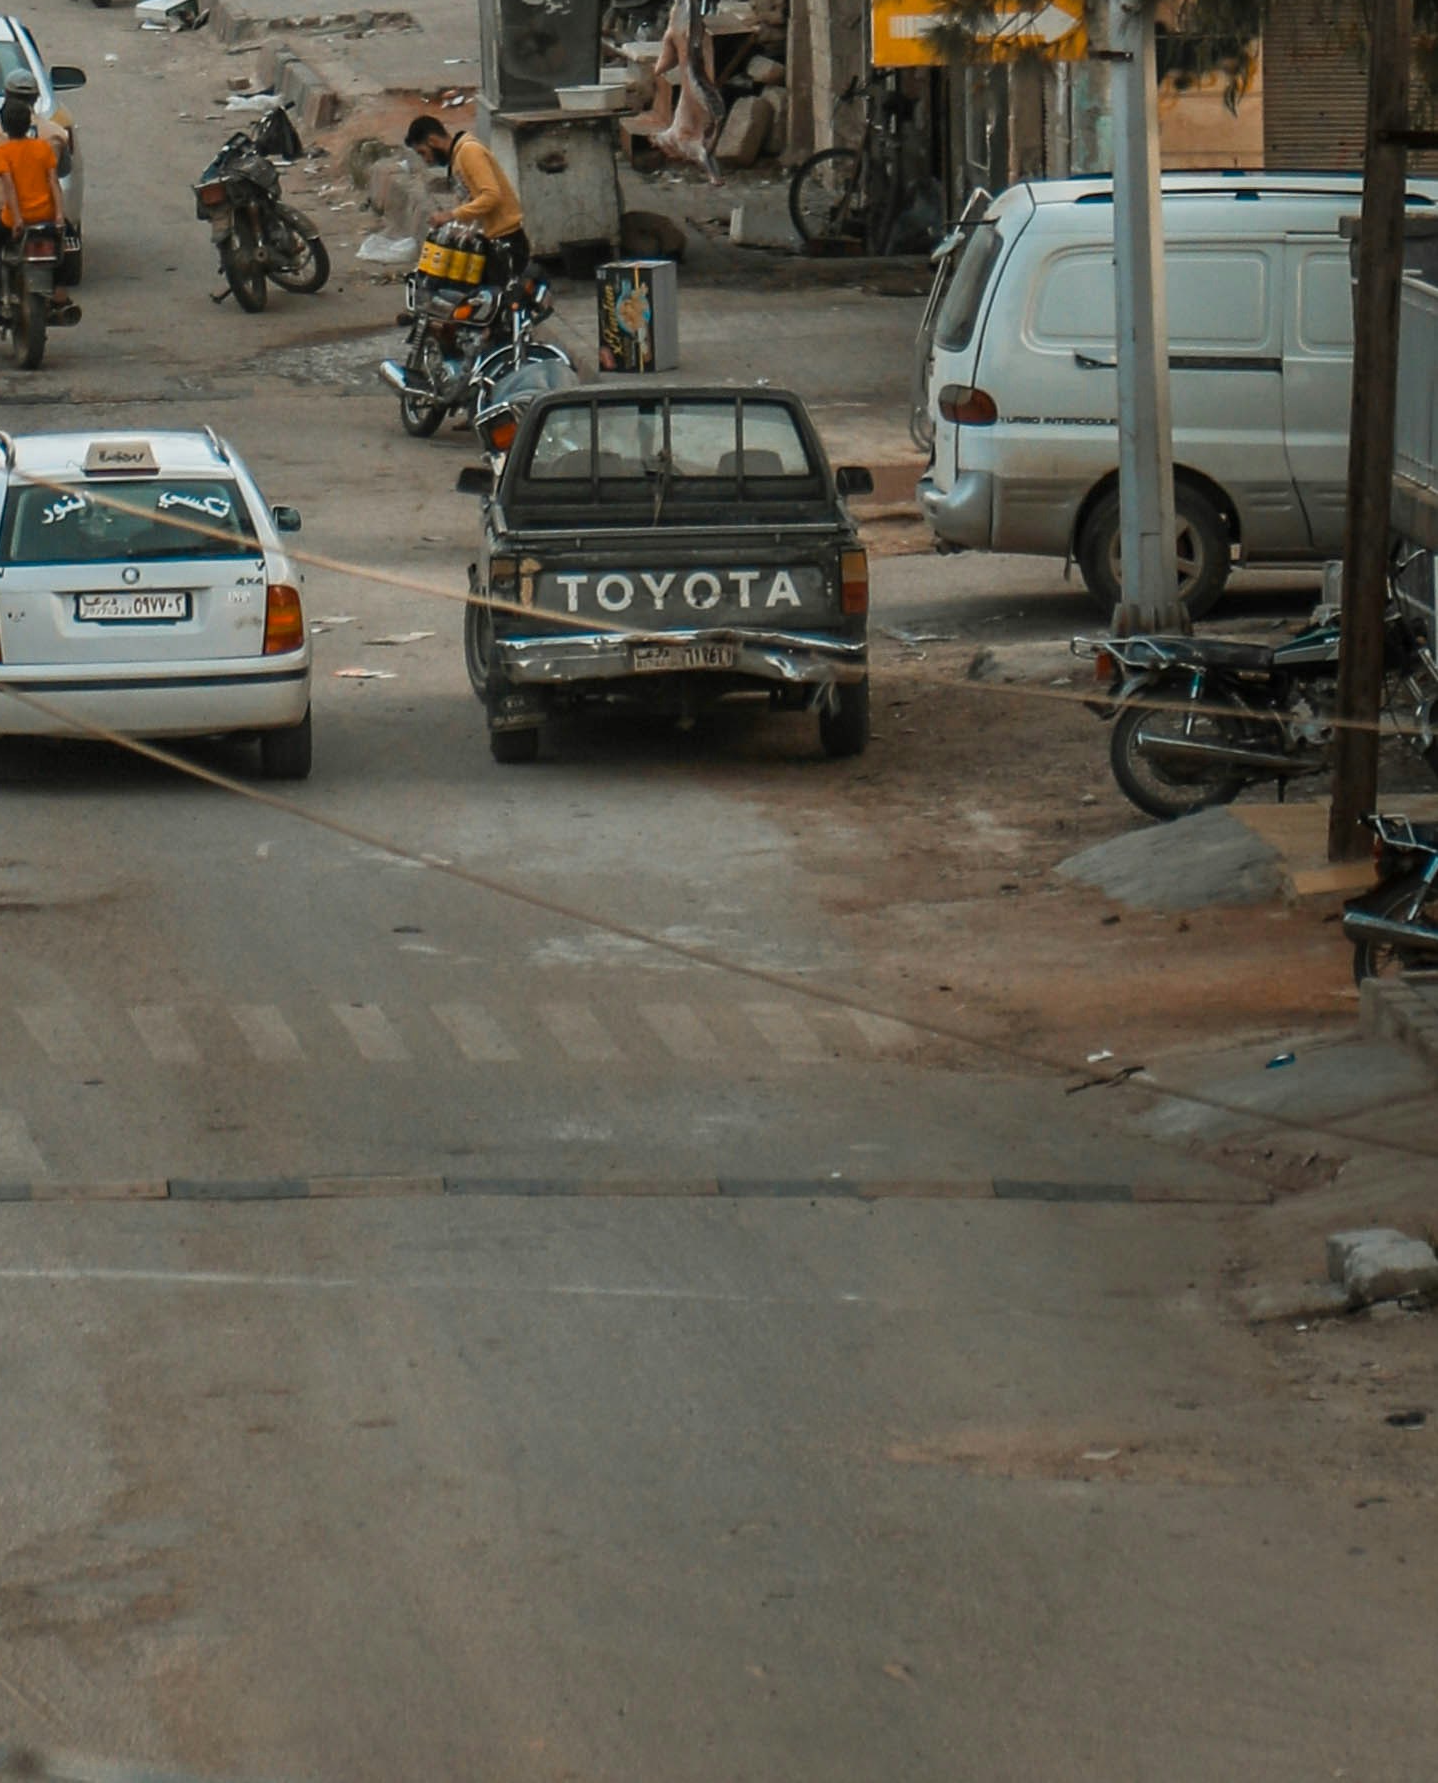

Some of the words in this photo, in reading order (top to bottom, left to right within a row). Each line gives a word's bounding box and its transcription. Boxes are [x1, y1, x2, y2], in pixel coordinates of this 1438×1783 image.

[1044, 416, 1118, 426] INTERCOOLE
[157, 491, 231, 519] تكسي
[556, 570, 803, 613] TOYOTA
[134, 596, 183, 614] ٥٩٧٧٠٢
